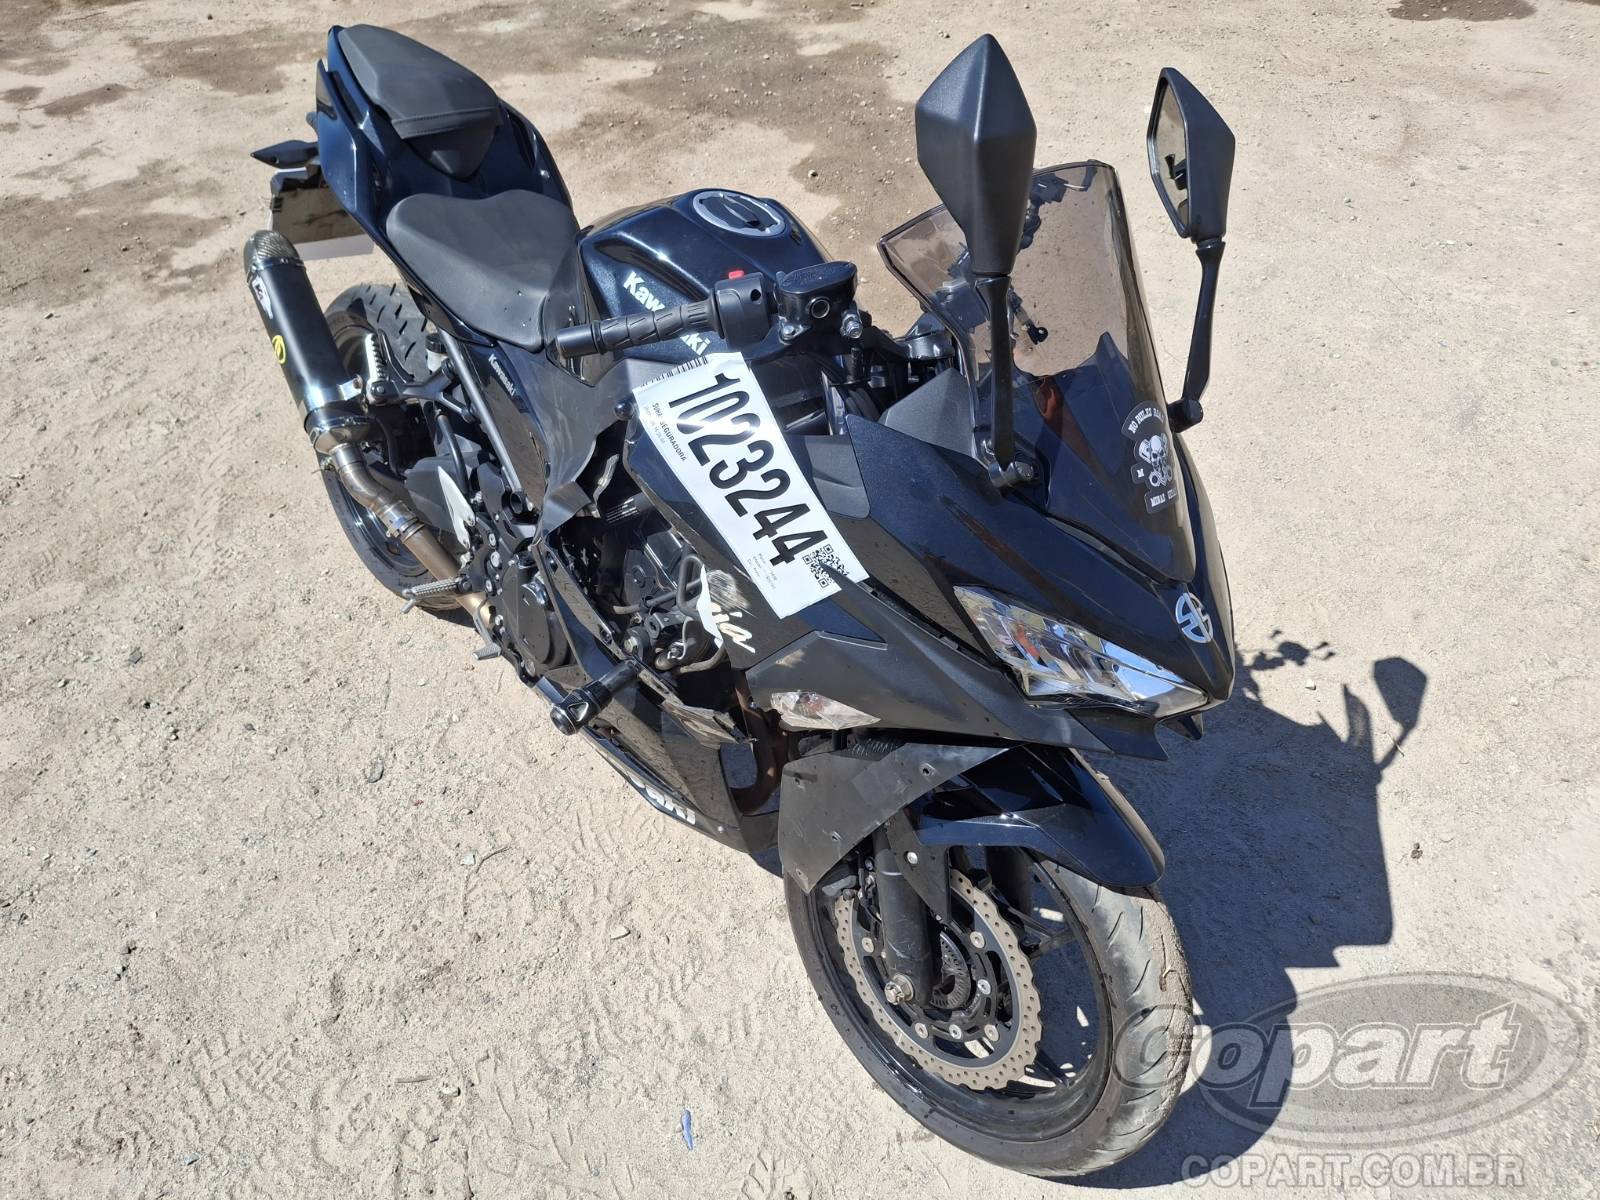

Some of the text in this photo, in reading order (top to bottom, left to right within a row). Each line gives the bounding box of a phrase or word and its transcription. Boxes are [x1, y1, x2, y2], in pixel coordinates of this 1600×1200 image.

[488, 353, 516, 397] Kawasaki
[1128, 420, 1138, 434] NO
[668, 373, 828, 566] 1023244
